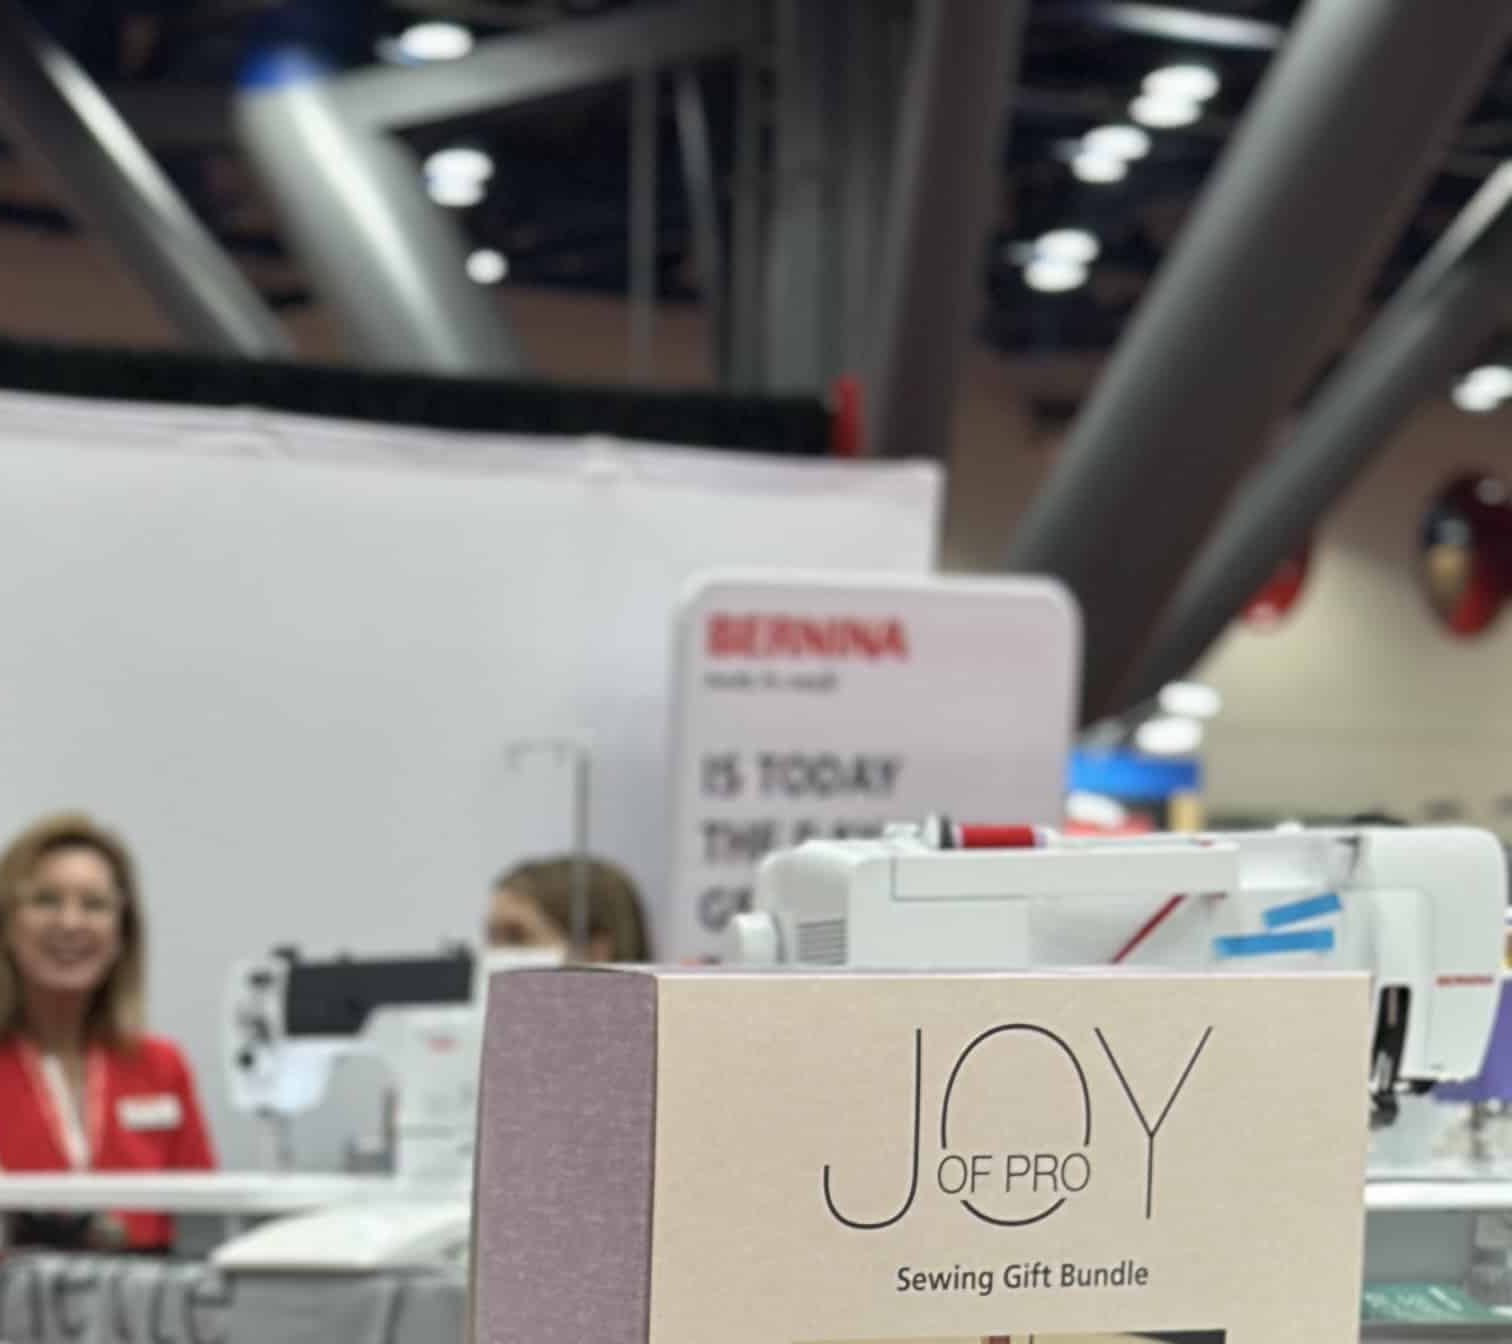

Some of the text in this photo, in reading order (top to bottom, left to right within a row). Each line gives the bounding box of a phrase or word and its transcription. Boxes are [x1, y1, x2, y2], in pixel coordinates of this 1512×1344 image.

[758, 754, 900, 798] TODAY
[823, 1023, 1213, 1229] JOY
[937, 1152, 1091, 1194] OF PRO
[896, 1260, 1149, 1297] Sewing Gift Bundle
